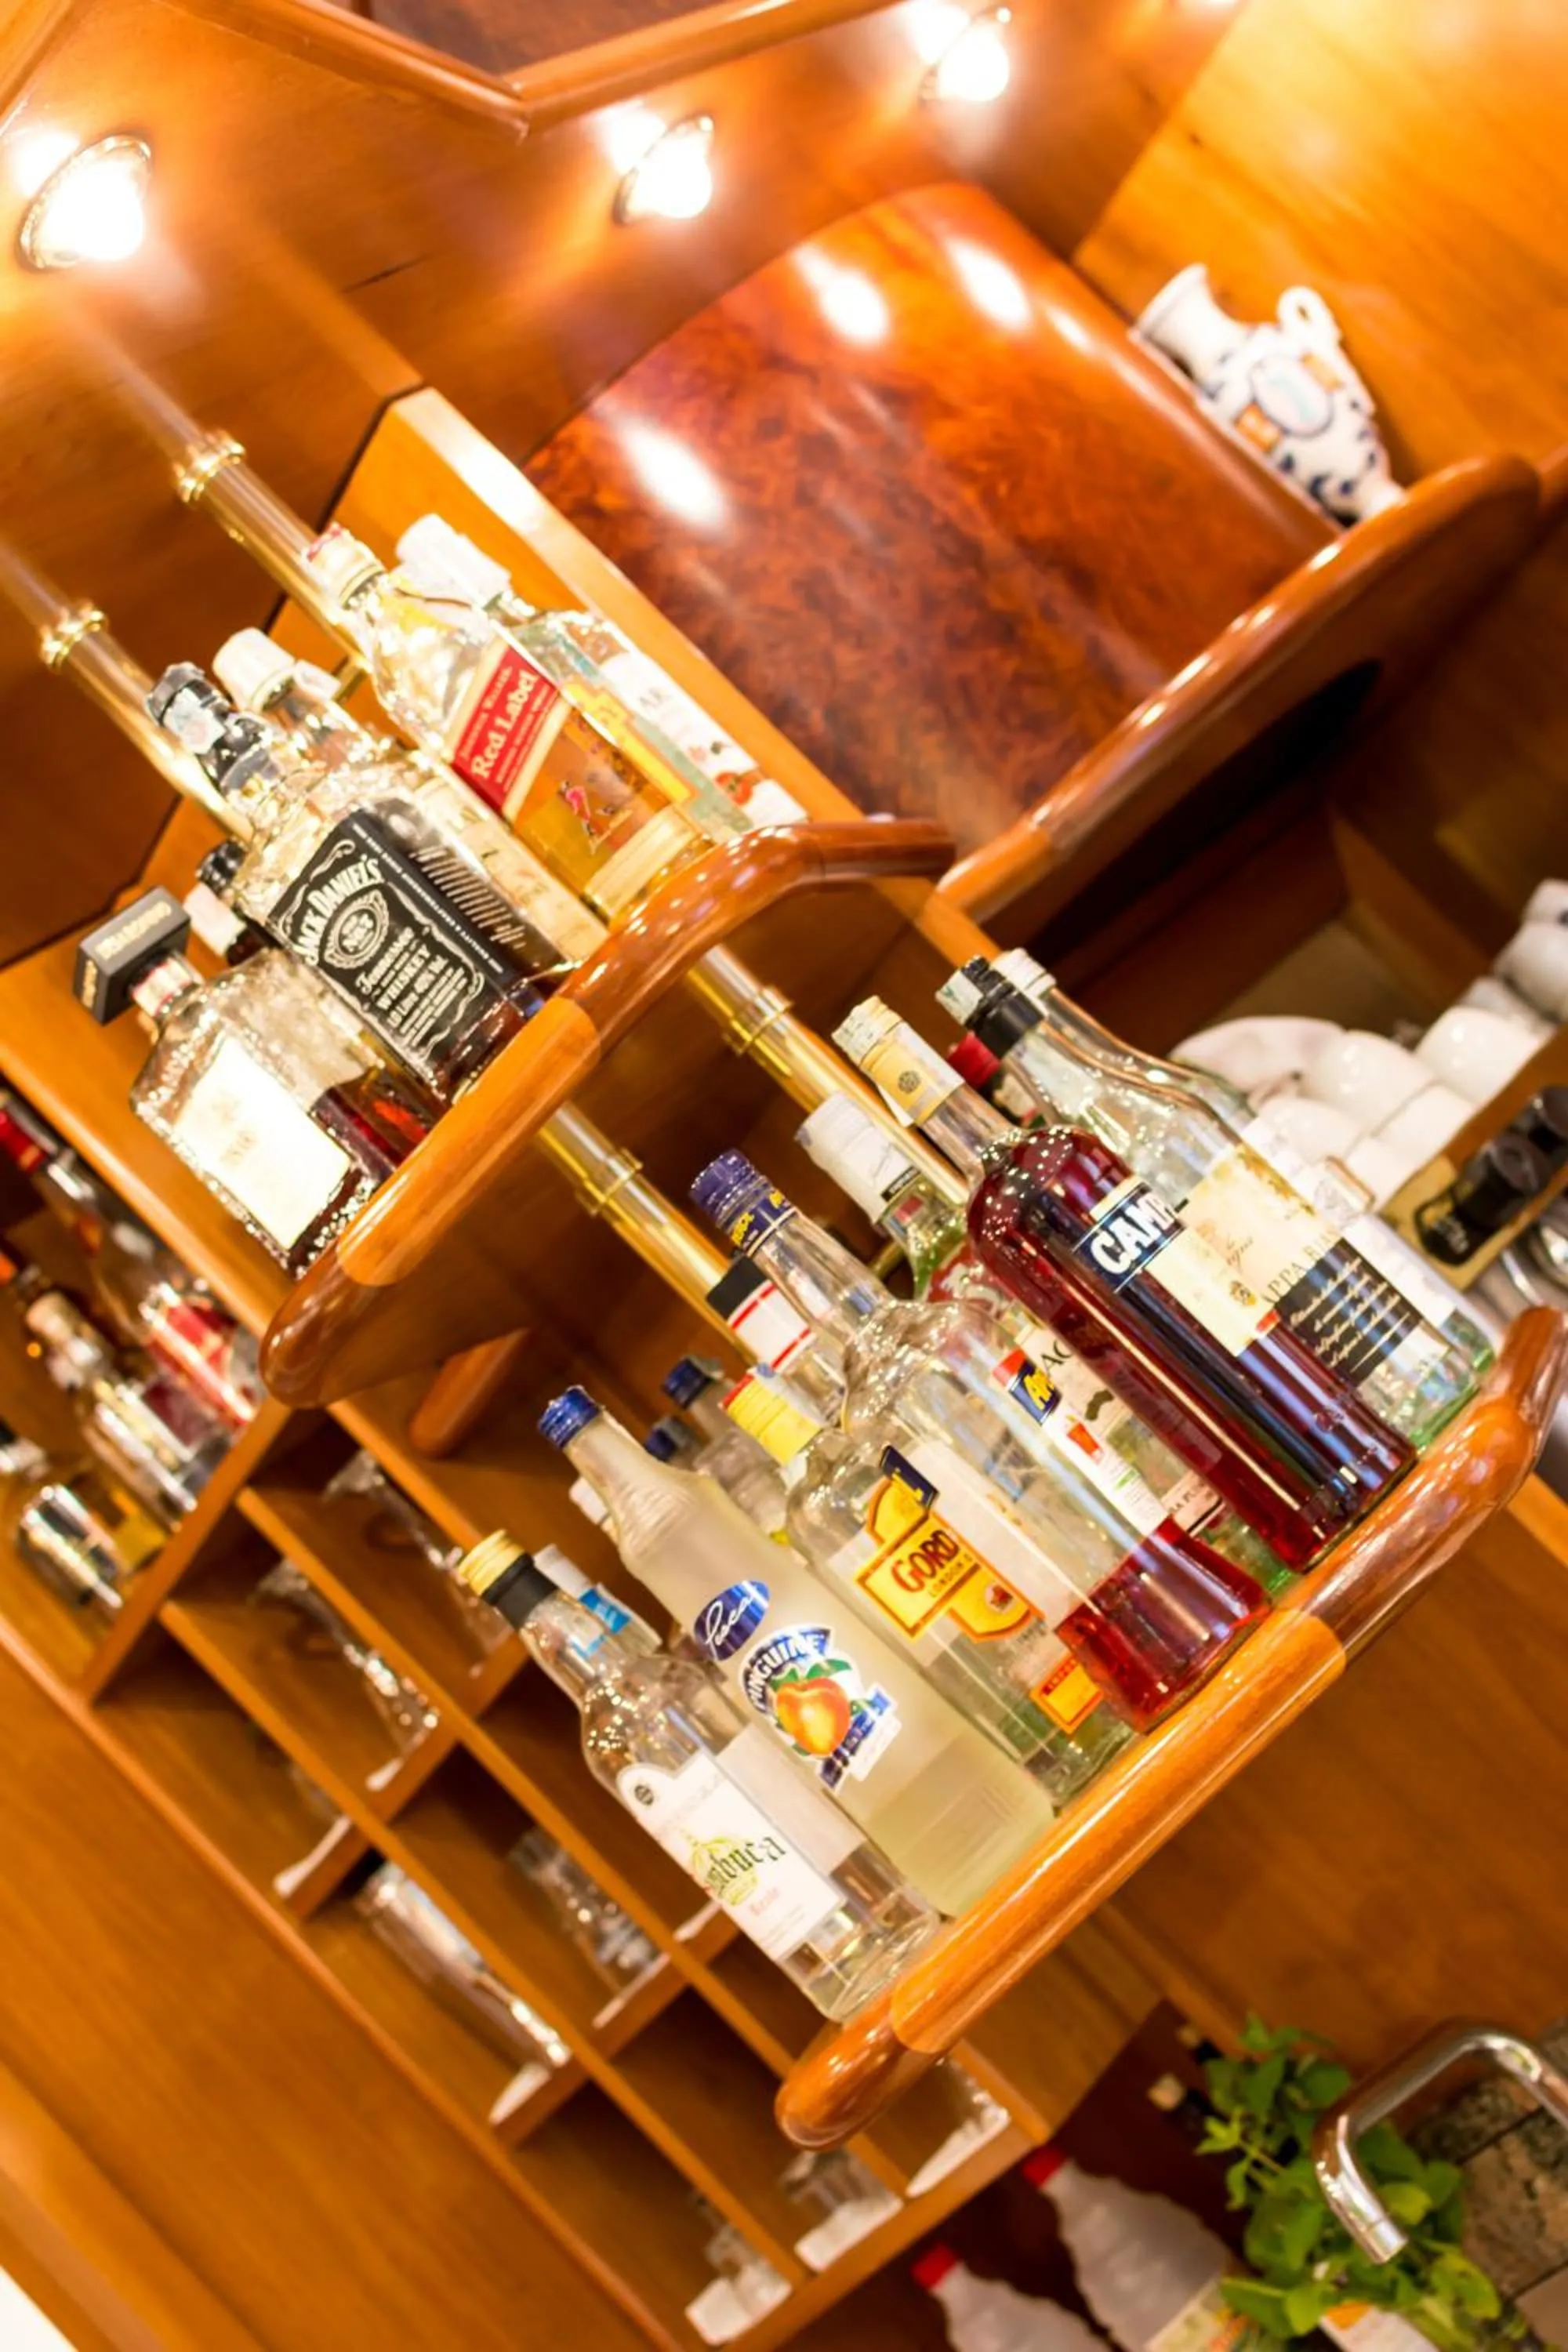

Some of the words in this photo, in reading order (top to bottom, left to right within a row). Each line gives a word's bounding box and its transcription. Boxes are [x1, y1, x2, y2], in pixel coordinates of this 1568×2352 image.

[471, 731, 506, 779] Red
[495, 669, 539, 730] Label
[307, 854, 384, 917] DANIEL'S
[292, 909, 327, 965] JACK
[376, 943, 430, 1011] WHISKEY
[891, 1529, 960, 1594] GORD
